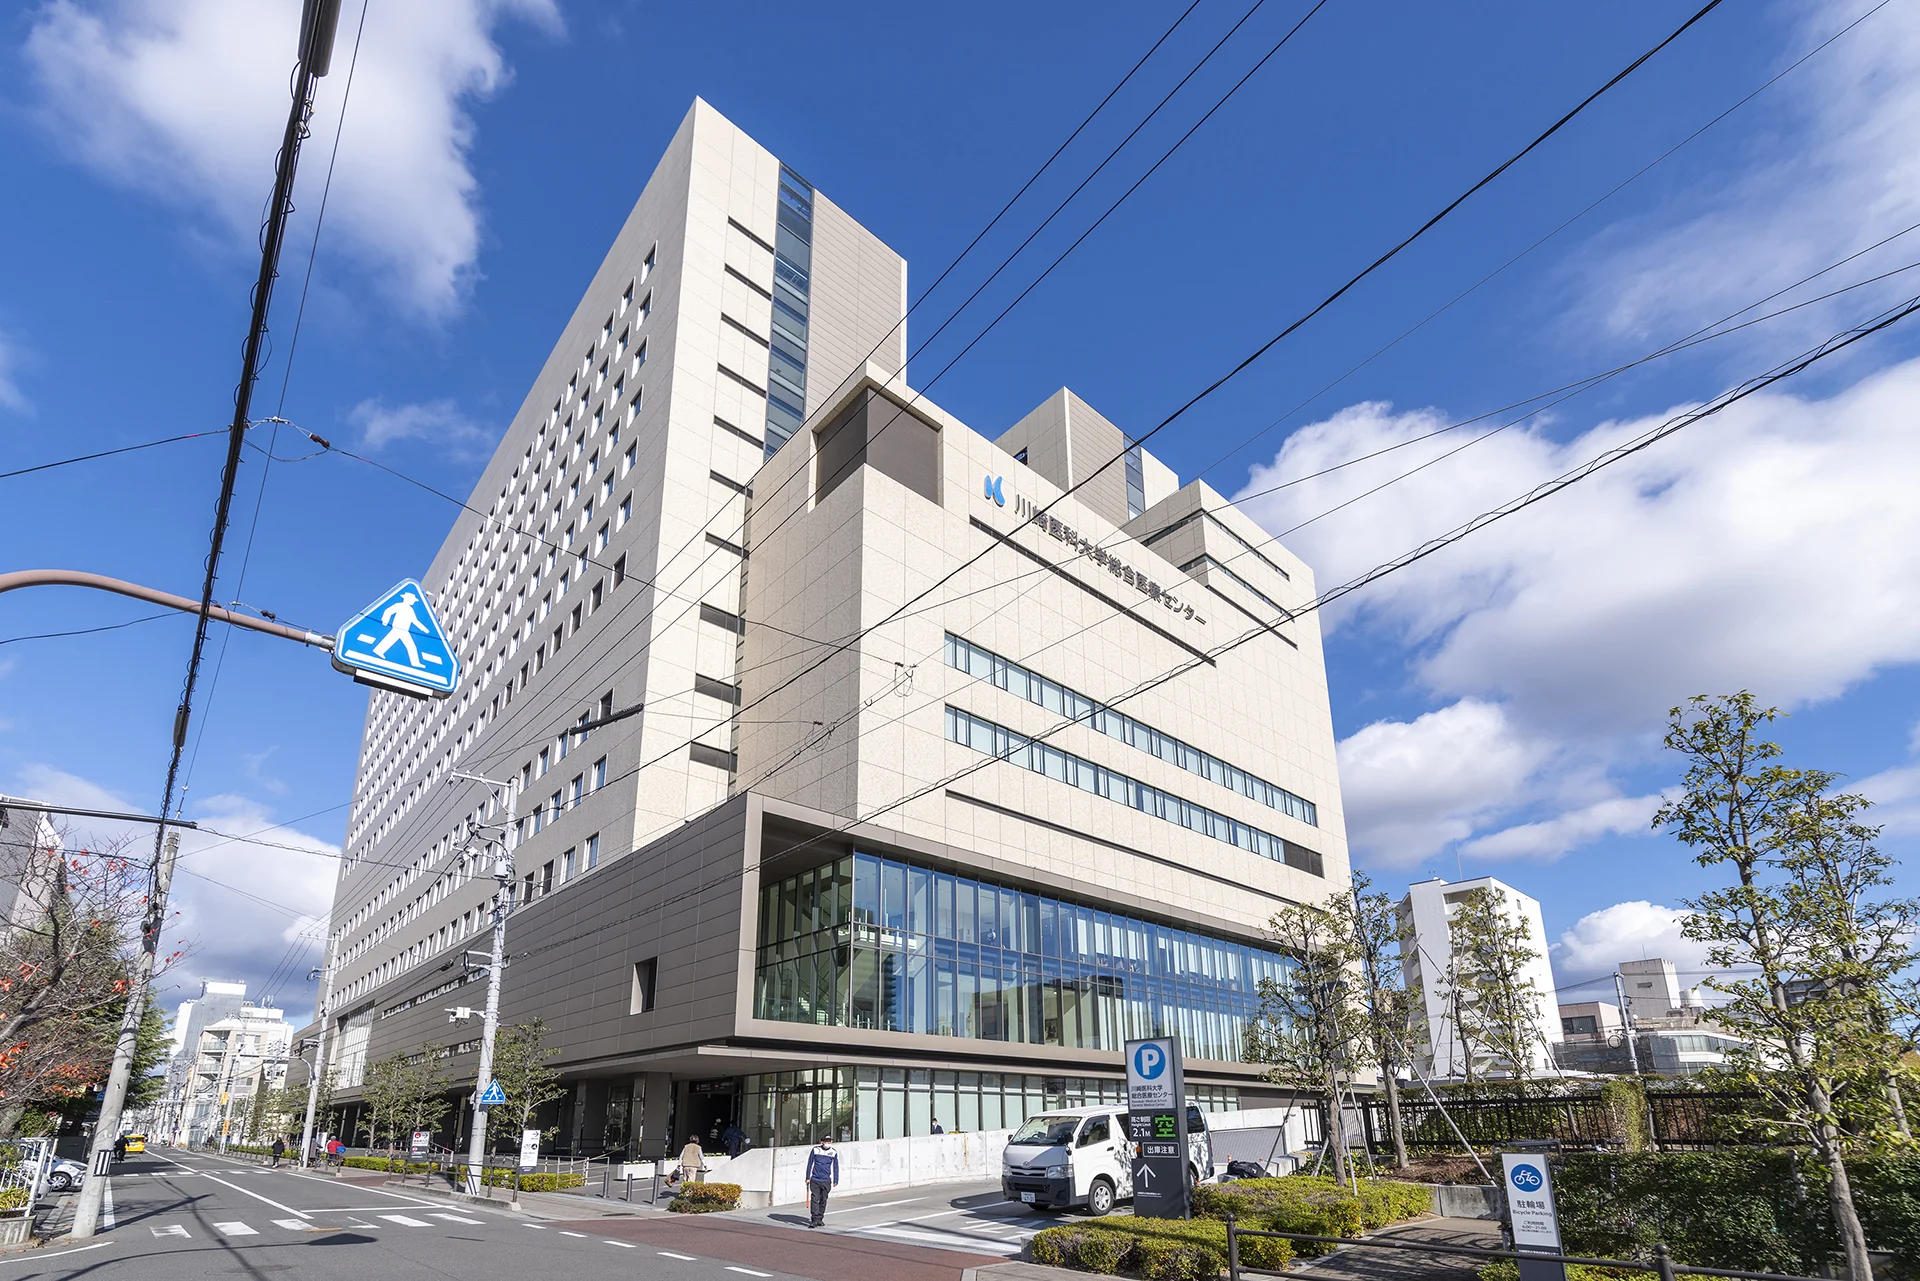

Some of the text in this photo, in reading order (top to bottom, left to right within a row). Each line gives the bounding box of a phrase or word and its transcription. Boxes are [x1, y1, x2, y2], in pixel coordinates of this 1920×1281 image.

[1141, 1048, 1160, 1076] P
[1131, 1091, 1173, 1099] 総合医療センター
[1154, 1114, 1176, 1137] 空
[1147, 1145, 1175, 1154] 出庫注意
[1516, 1200, 1545, 1209] 駐輪場
